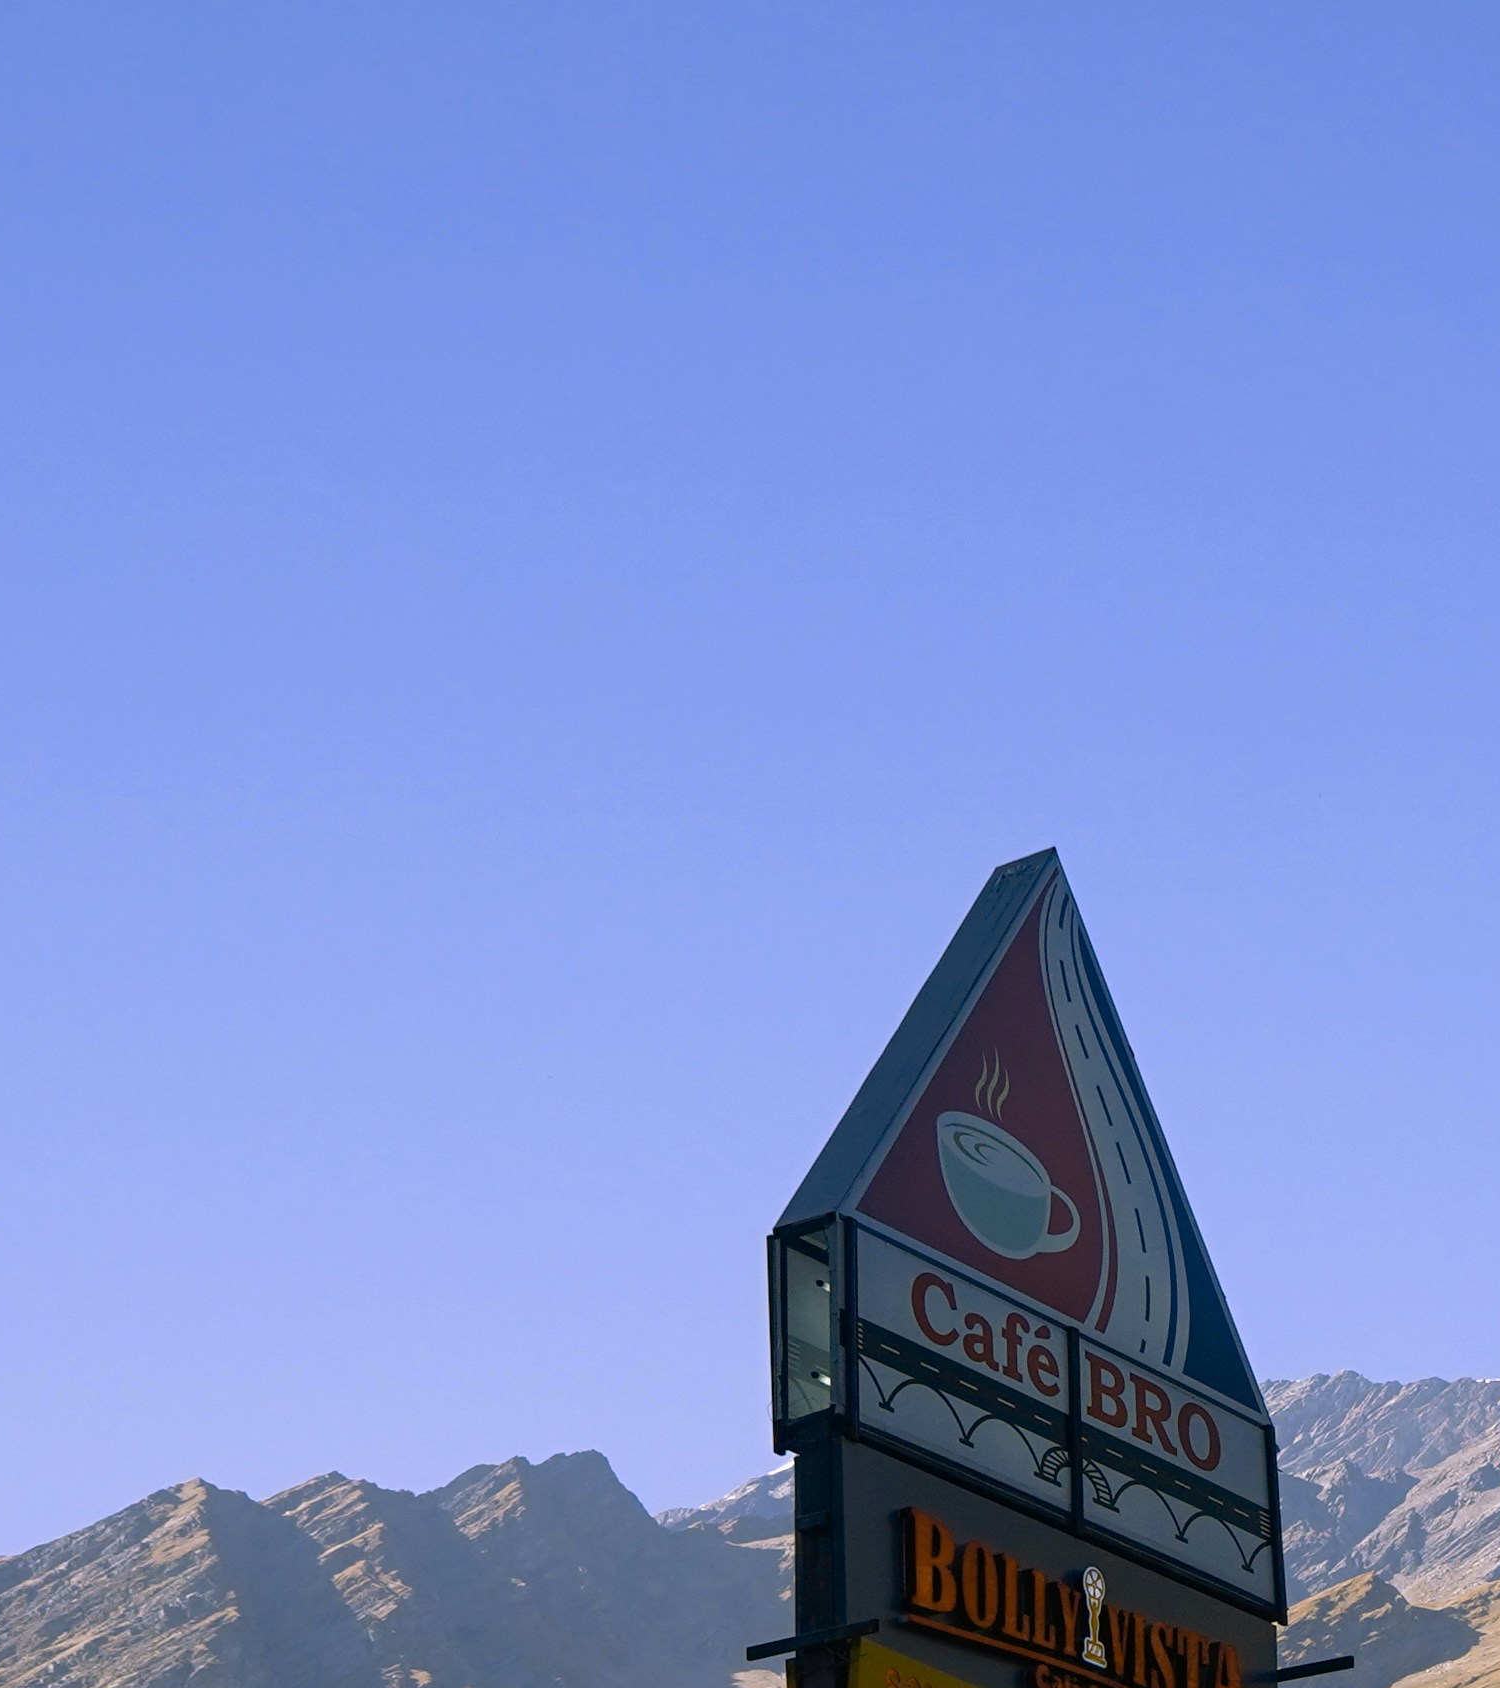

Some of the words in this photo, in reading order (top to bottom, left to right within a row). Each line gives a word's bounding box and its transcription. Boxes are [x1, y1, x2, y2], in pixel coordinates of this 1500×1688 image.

[911, 1272, 1062, 1398] Café
[1084, 1351, 1221, 1472] BRO
[907, 1507, 1081, 1659] BOLLY
